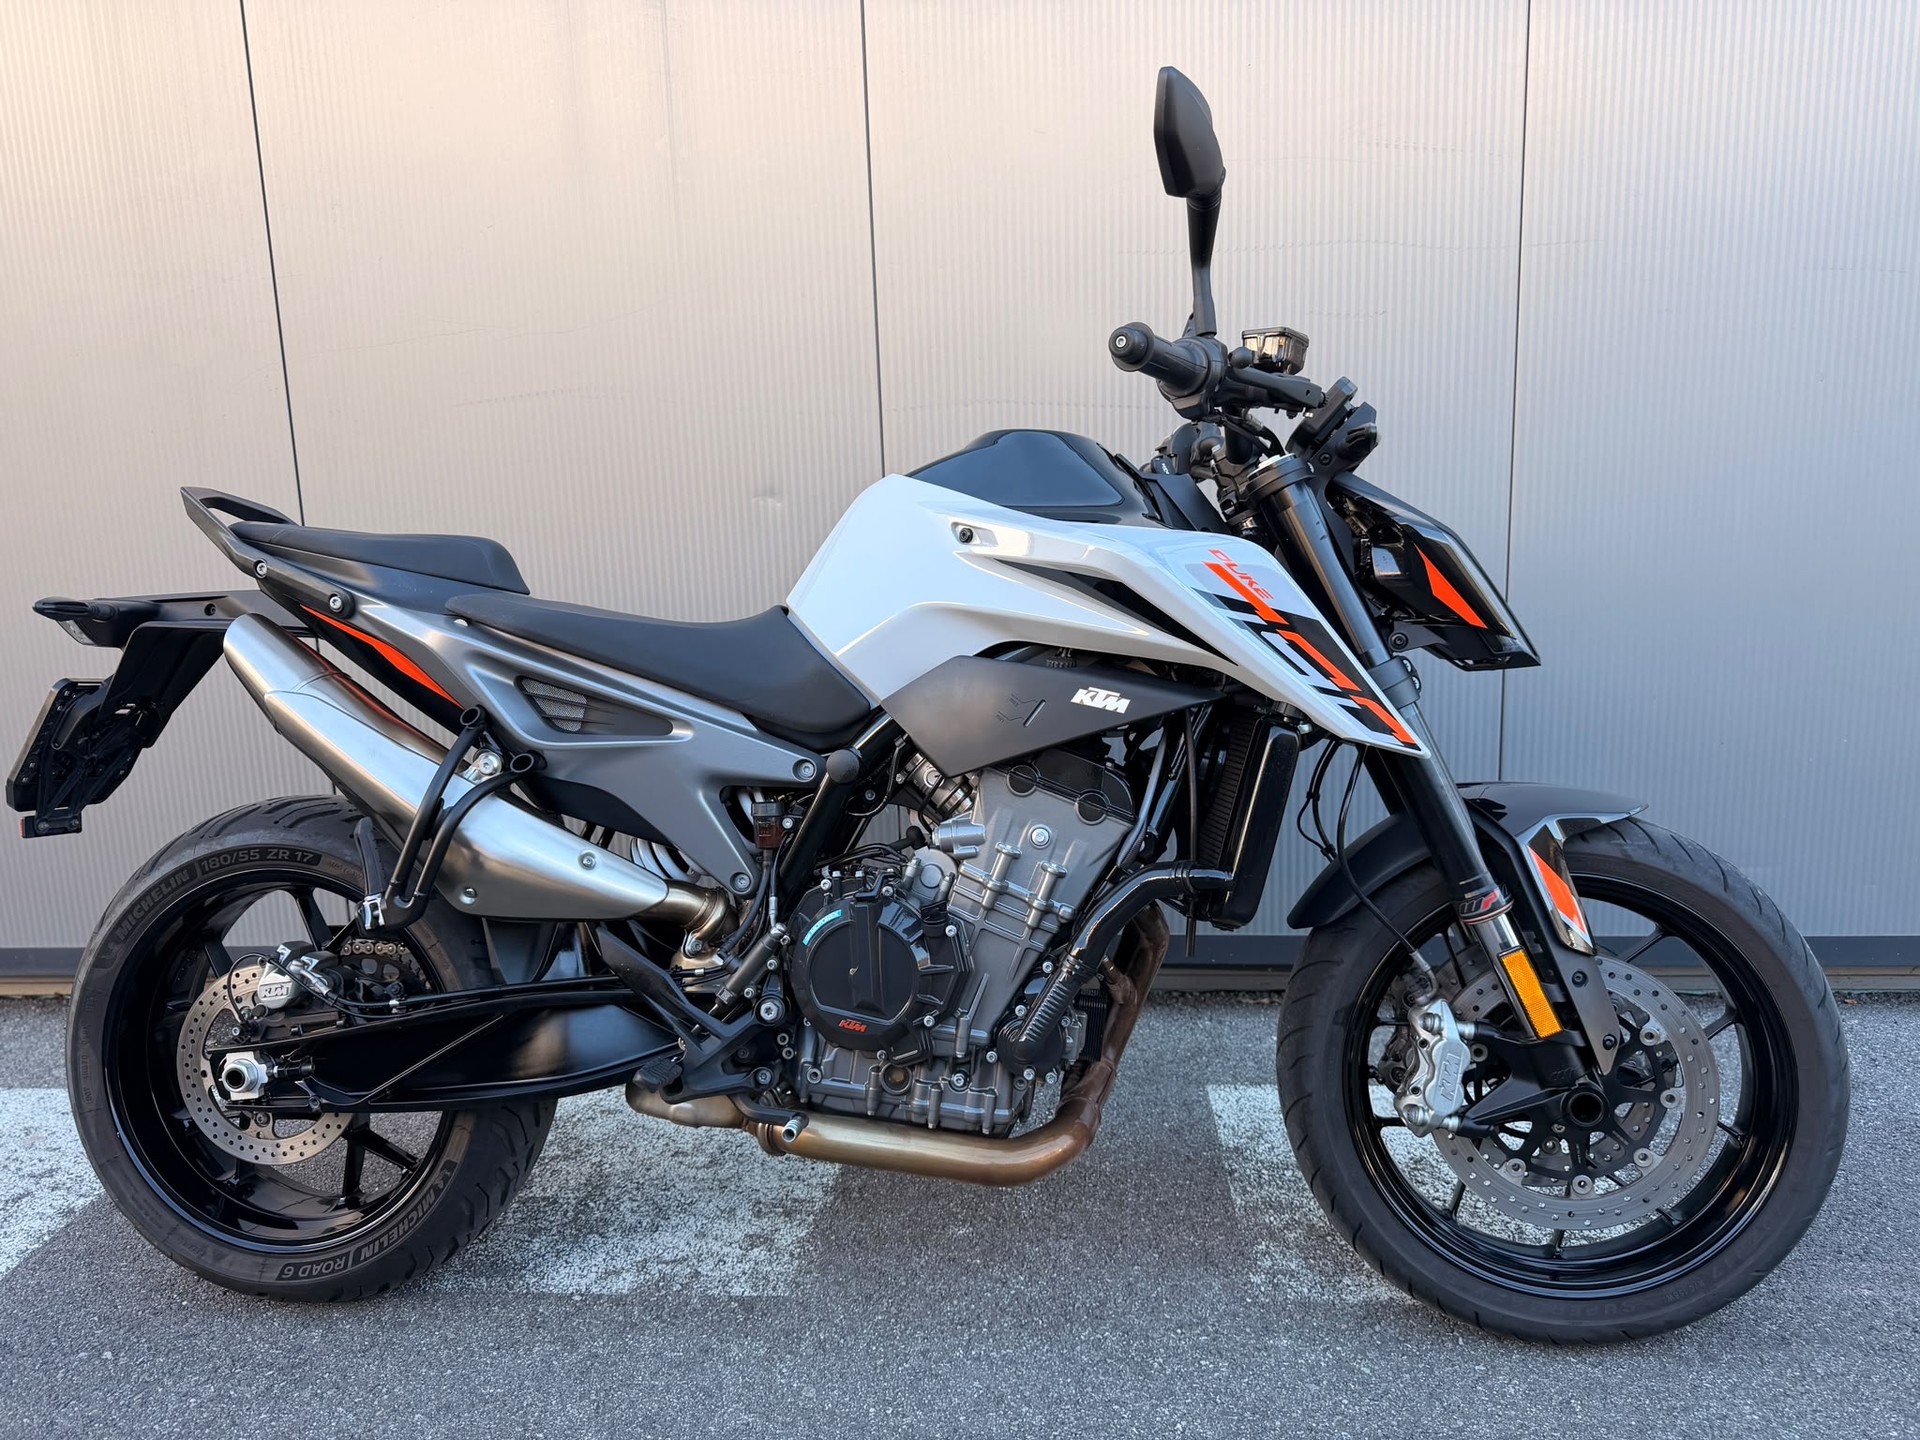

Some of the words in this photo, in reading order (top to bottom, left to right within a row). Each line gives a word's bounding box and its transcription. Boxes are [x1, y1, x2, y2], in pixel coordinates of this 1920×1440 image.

[1208, 549, 1274, 600] DUKE
[1070, 686, 1131, 714] KTM
[115, 869, 190, 941] MICHELIN
[201, 849, 260, 872] 180/55
[266, 849, 290, 860] ZR
[294, 851, 314, 863] 17
[260, 984, 290, 998] KTM
[839, 1019, 867, 1033] KTM
[1439, 1053, 1460, 1102] KTM
[360, 1188, 436, 1261] MICHELIN
[281, 1265, 295, 1279] 6
[299, 1256, 346, 1278] ROAD
